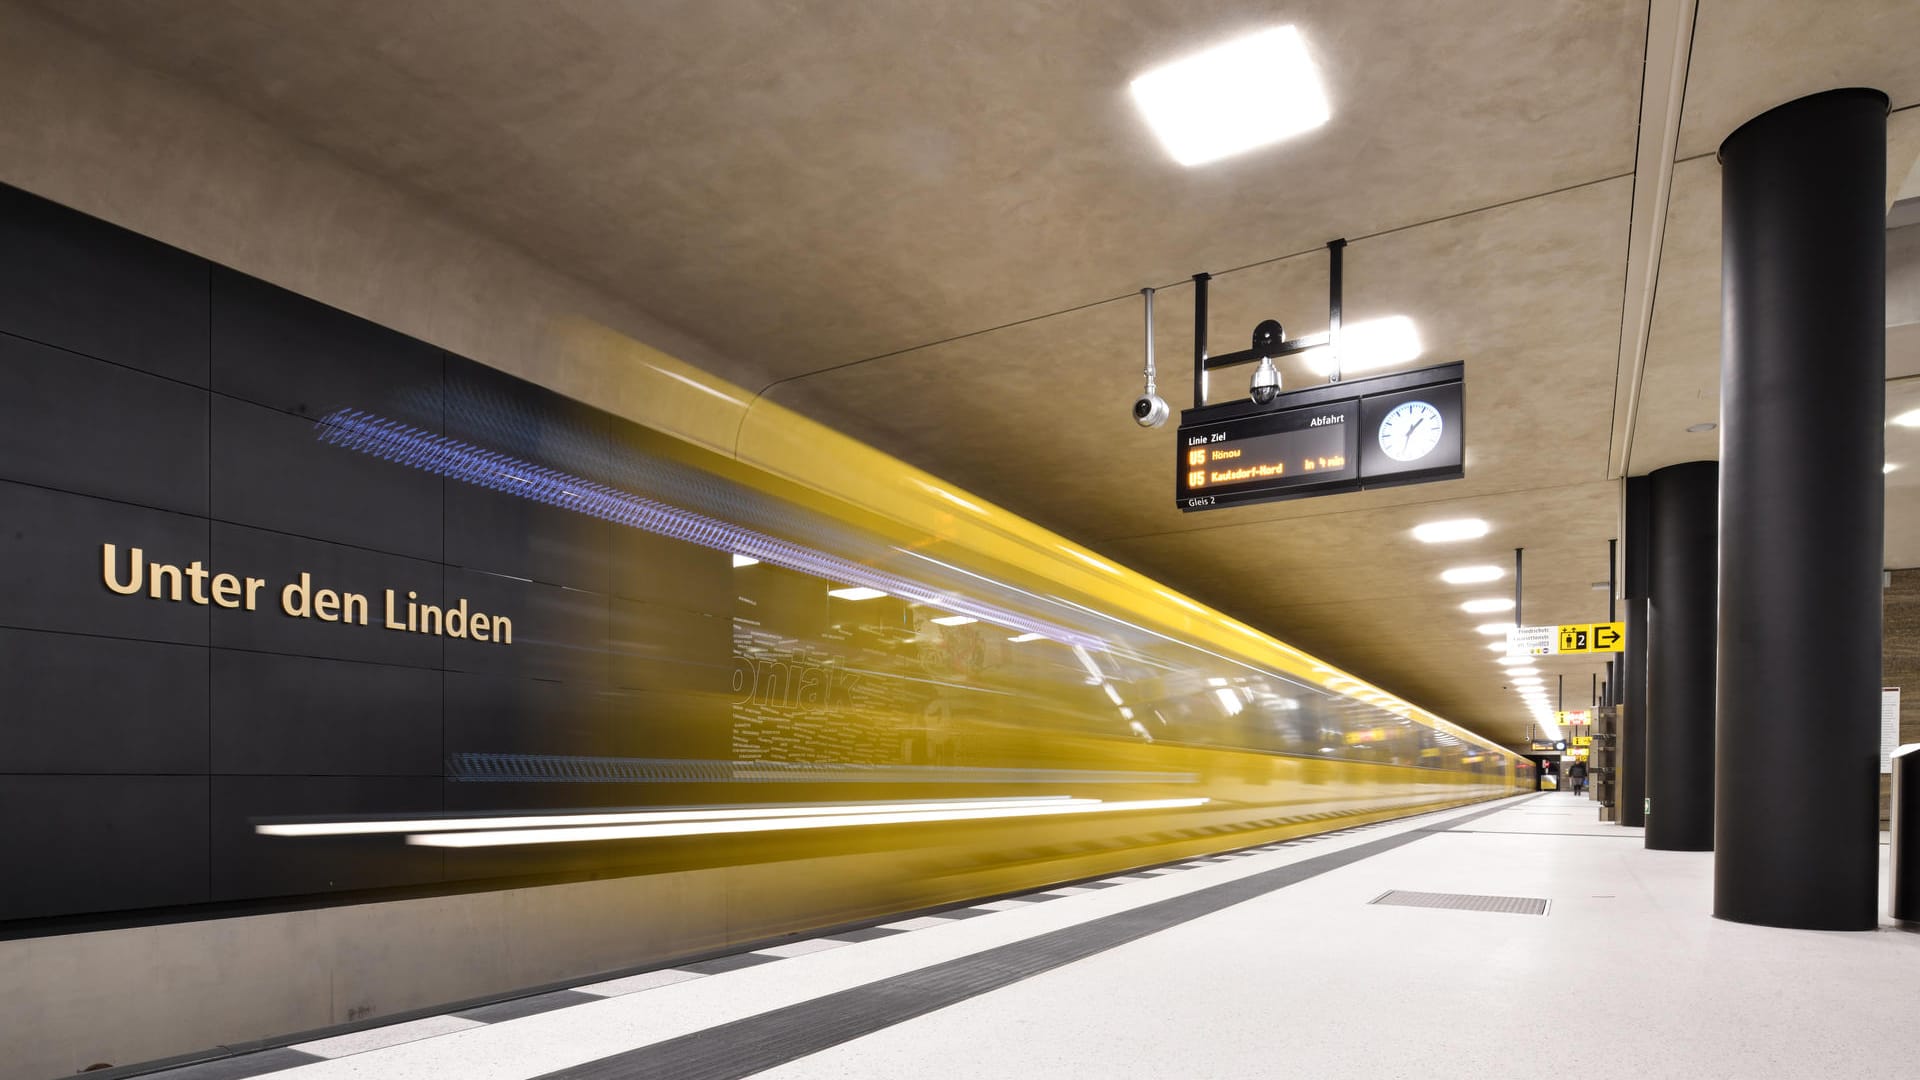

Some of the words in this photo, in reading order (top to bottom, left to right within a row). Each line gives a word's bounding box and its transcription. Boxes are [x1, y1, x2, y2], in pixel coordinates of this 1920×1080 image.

[1310, 414, 1345, 427] Abfahrt
[1188, 436, 1208, 446] Linie
[1211, 432, 1226, 443] Ziel
[1189, 450, 1206, 465] U5
[1189, 471, 1205, 486] U5
[1211, 463, 1283, 482] Kaulsdorf-Nord
[1305, 459, 1315, 470] in
[1188, 497, 1208, 507] Gleis
[1210, 496, 1216, 505] 2
[102, 543, 265, 611] Unter
[281, 572, 369, 626] den
[385, 589, 513, 645] Linden
[1577, 635, 1585, 646] 2
